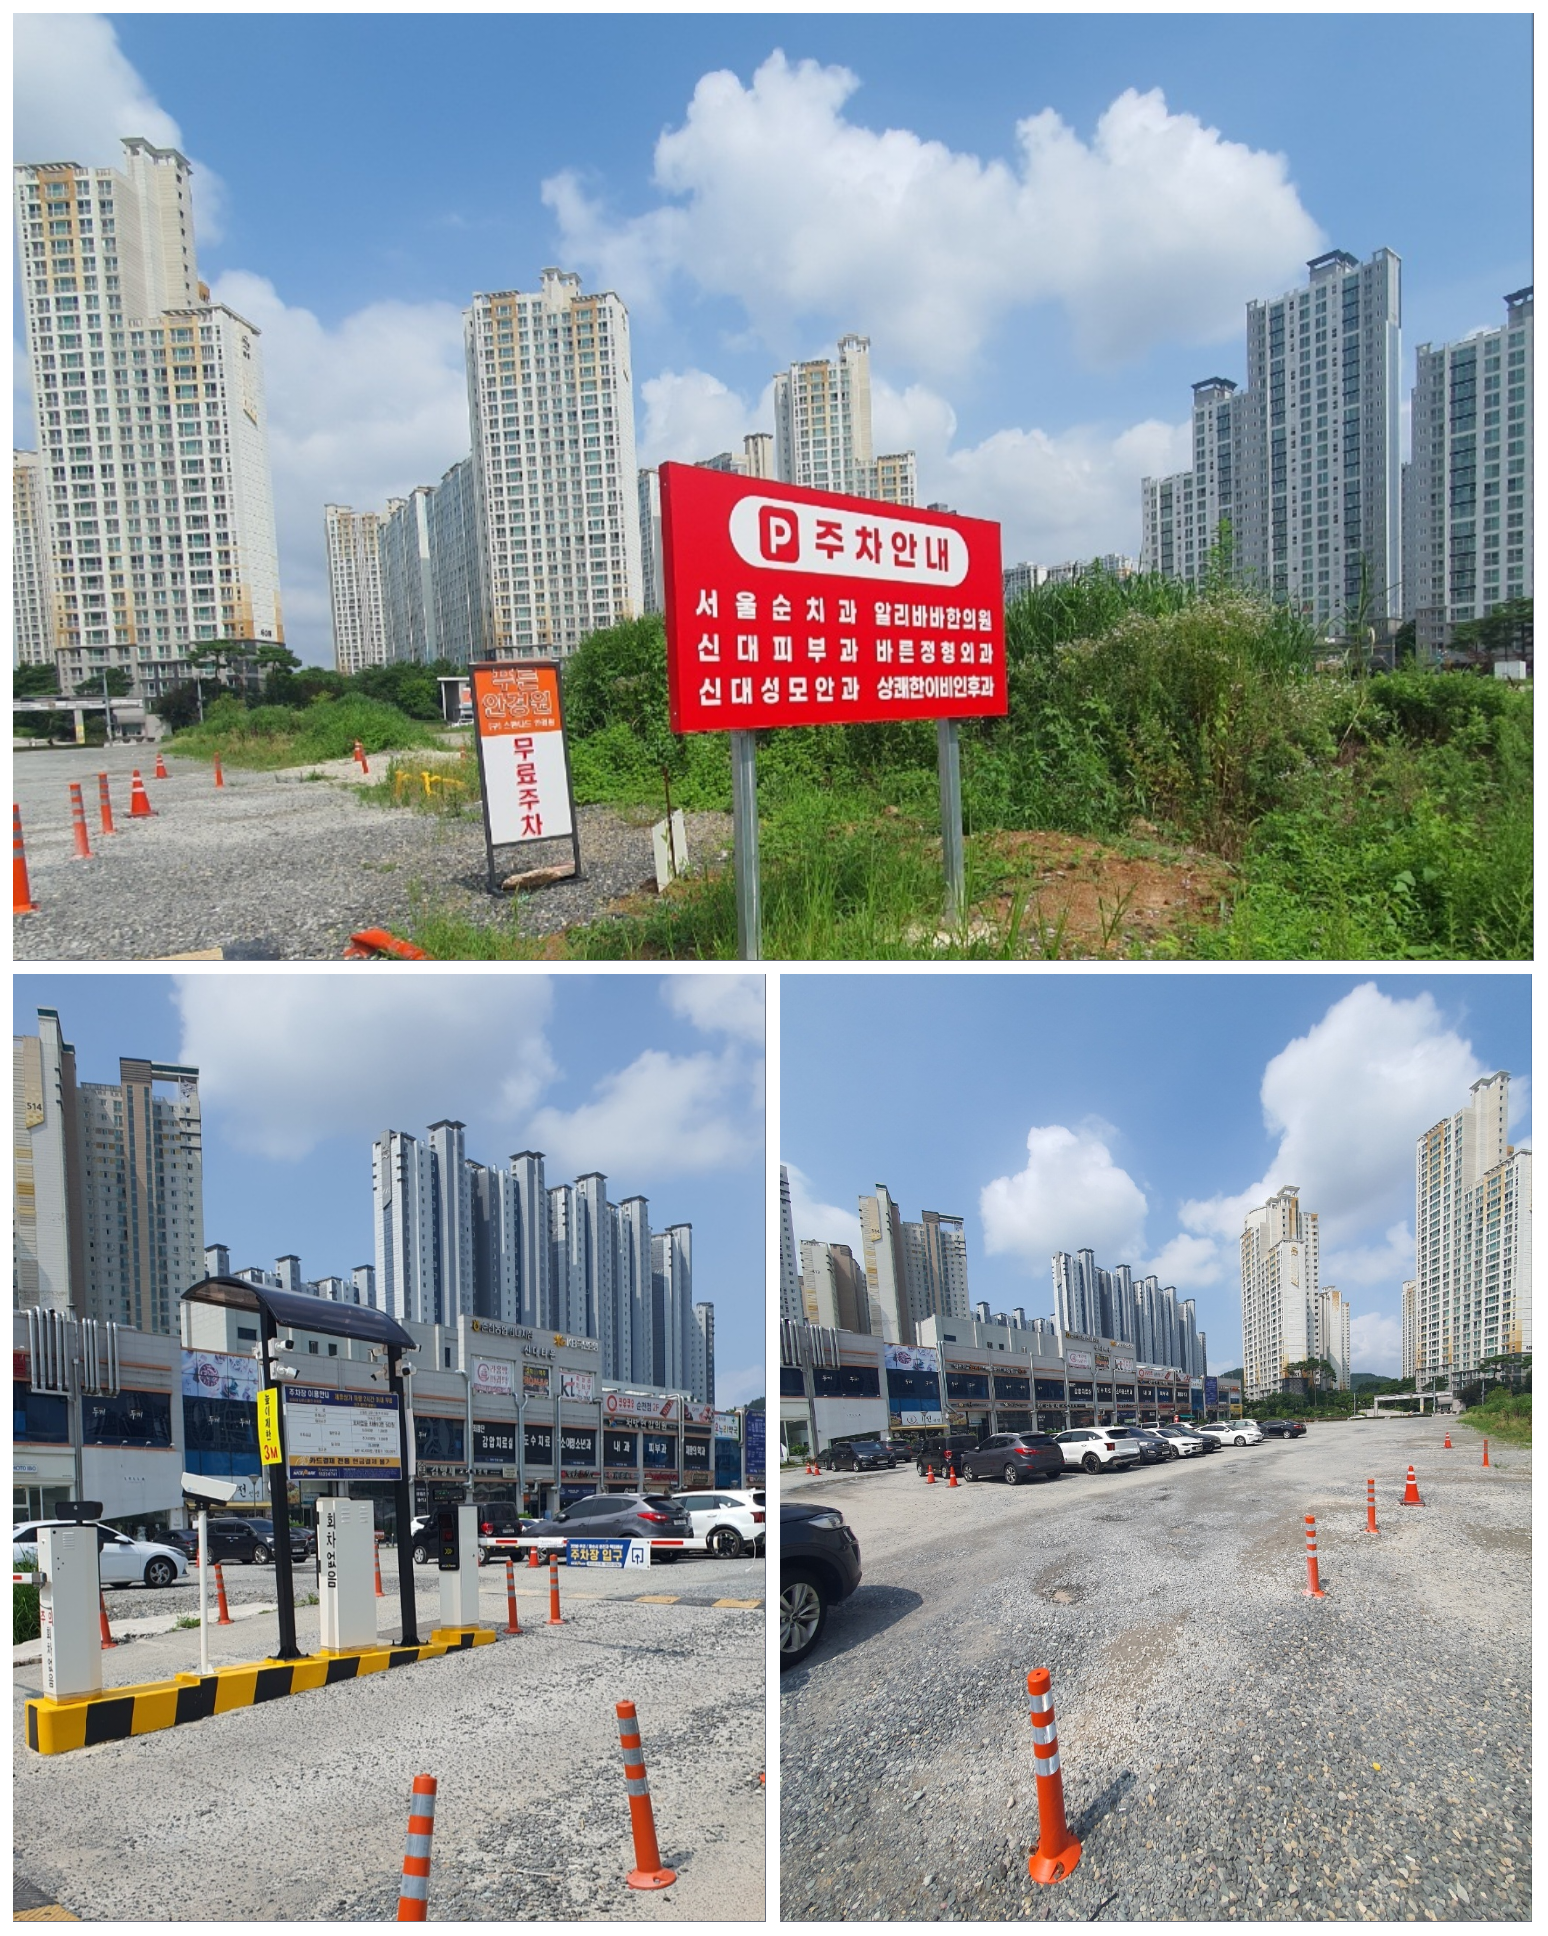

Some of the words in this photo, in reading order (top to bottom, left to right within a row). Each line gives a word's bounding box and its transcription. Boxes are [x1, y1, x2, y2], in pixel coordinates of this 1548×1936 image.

[769, 515, 793, 554] P
[815, 519, 949, 573] 주차안내
[874, 602, 993, 632] 알리바바한의원
[876, 638, 994, 665] 바른정형외과
[482, 690, 553, 718] 안경원
[699, 676, 860, 706] 신대성모안과
[877, 675, 995, 701] 상쾌한이비인후과
[512, 736, 544, 838] 무료주차
[26, 1102, 42, 1111] 514
[288, 1388, 307, 1398] 주차장
[636, 1401, 652, 1412] 순천점
[264, 1444, 278, 1460] 3M
[482, 1435, 514, 1450] 감압치료실
[648, 1442, 668, 1455] 피부과
[326, 1512, 337, 1589] 회차없음
[570, 1548, 600, 1561] 주차장
[602, 1549, 623, 1562] 입구
